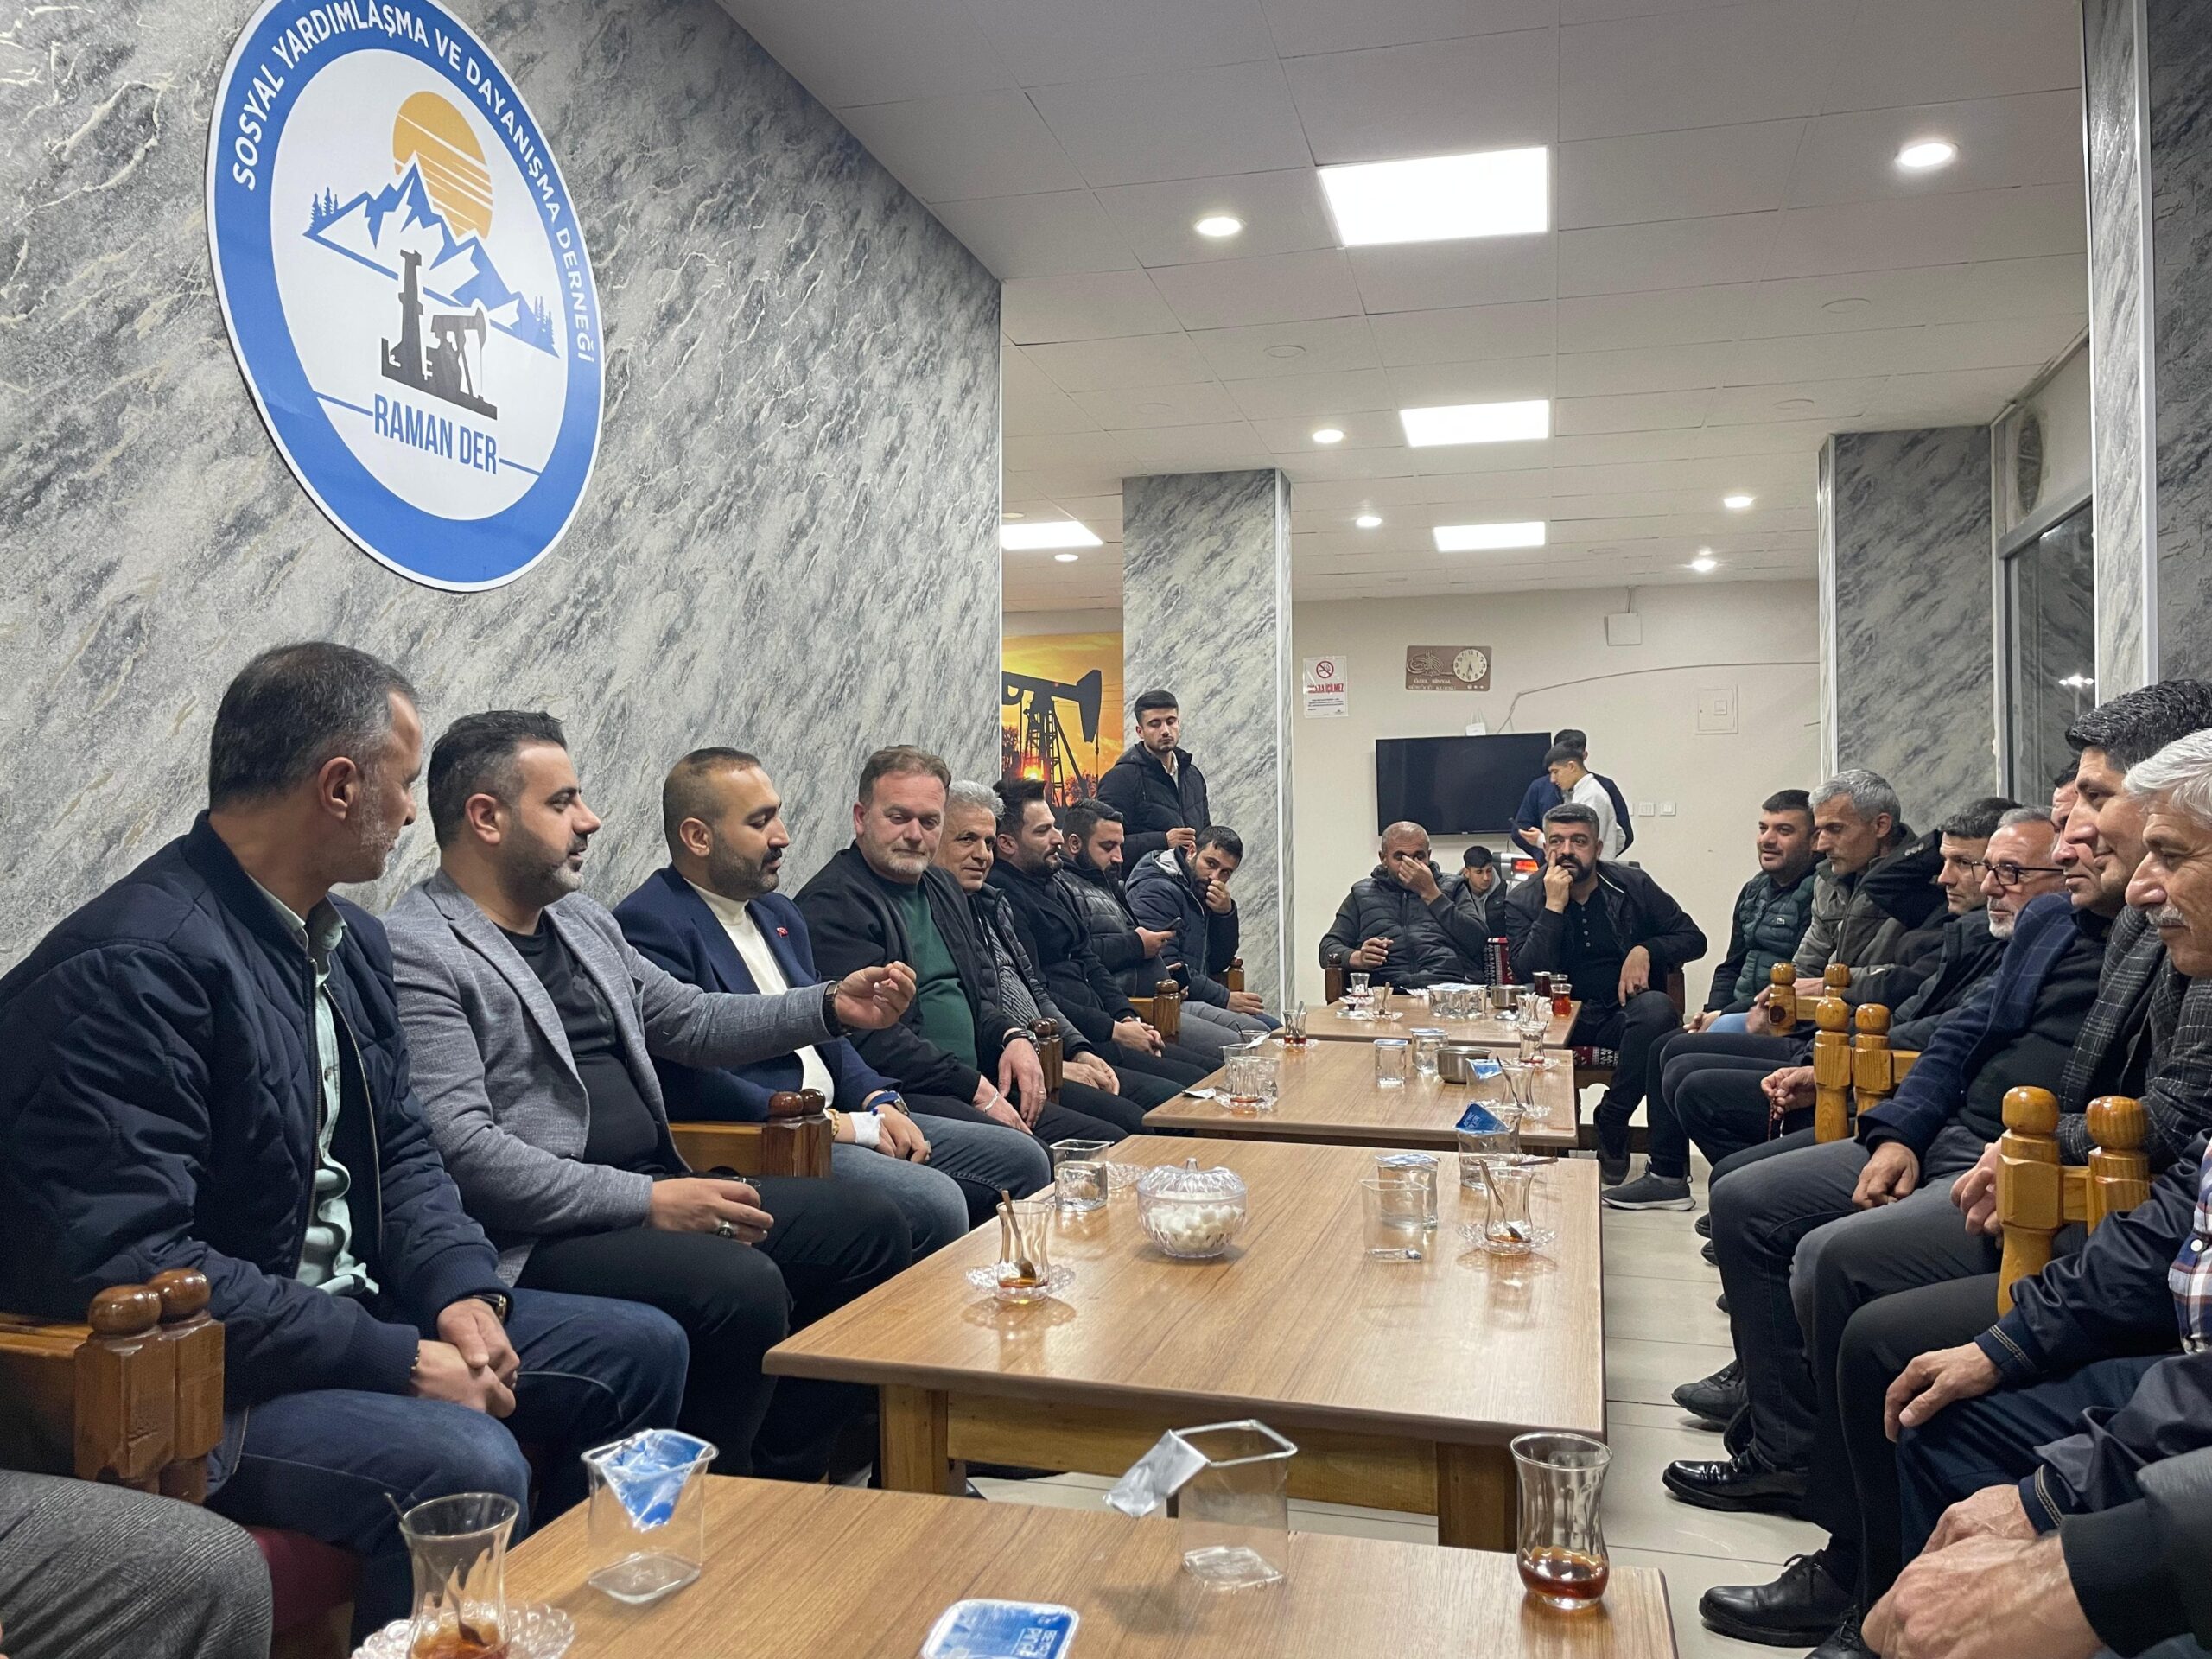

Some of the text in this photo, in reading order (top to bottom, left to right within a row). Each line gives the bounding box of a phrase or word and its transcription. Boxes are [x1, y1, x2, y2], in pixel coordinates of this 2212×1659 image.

[232, 0, 597, 363] SOSYAL YARDIMLAŞMA VE DAYANIŞMA DERNEĞİ
[374, 393, 497, 474] RAMAN DER
